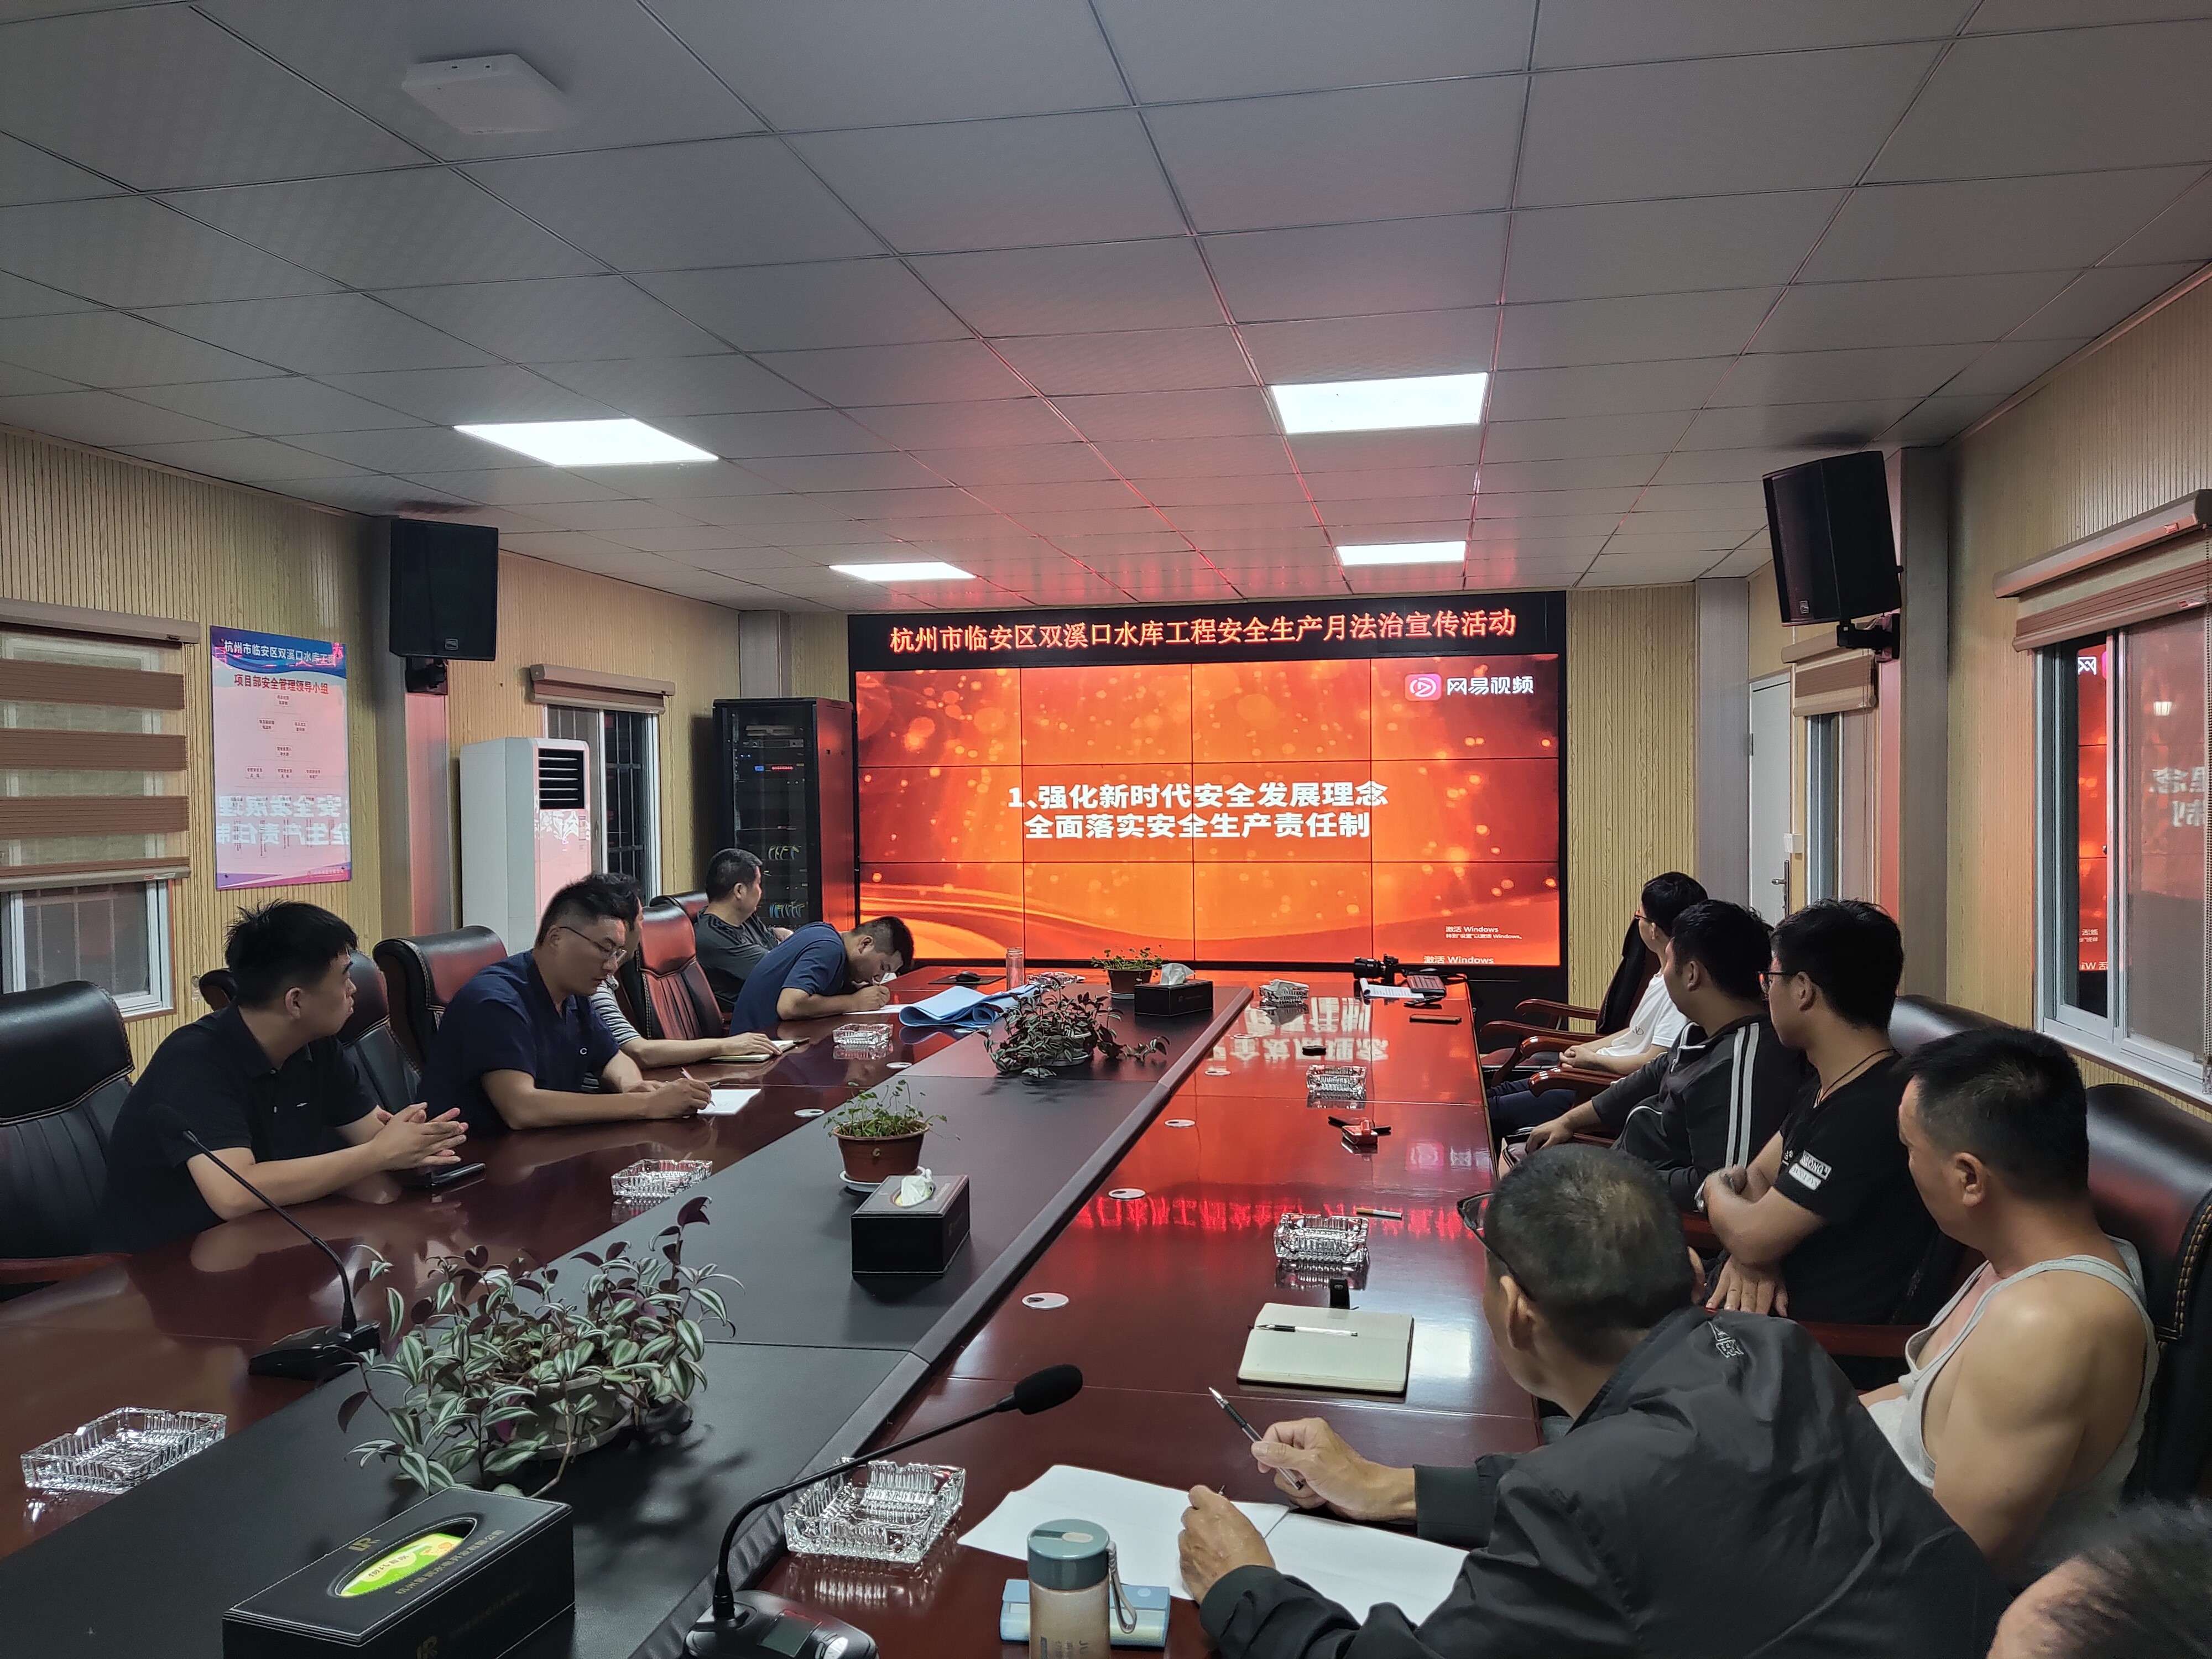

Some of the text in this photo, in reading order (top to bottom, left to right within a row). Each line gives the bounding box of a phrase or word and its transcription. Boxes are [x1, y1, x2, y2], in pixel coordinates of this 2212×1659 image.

[889, 608, 1517, 654] 杭州市临安区双溪口水库工程安全生产月法治宣传活动
[234, 674, 328, 694] 项目部安全管理领导小组
[1447, 676, 1534, 695] 网易视频
[1008, 780, 1389, 810] 1、强化新时代安全发展理念
[1024, 812, 1369, 839] 全面落实安全生产责任制
[1423, 955, 1494, 964] 激活 Windows
